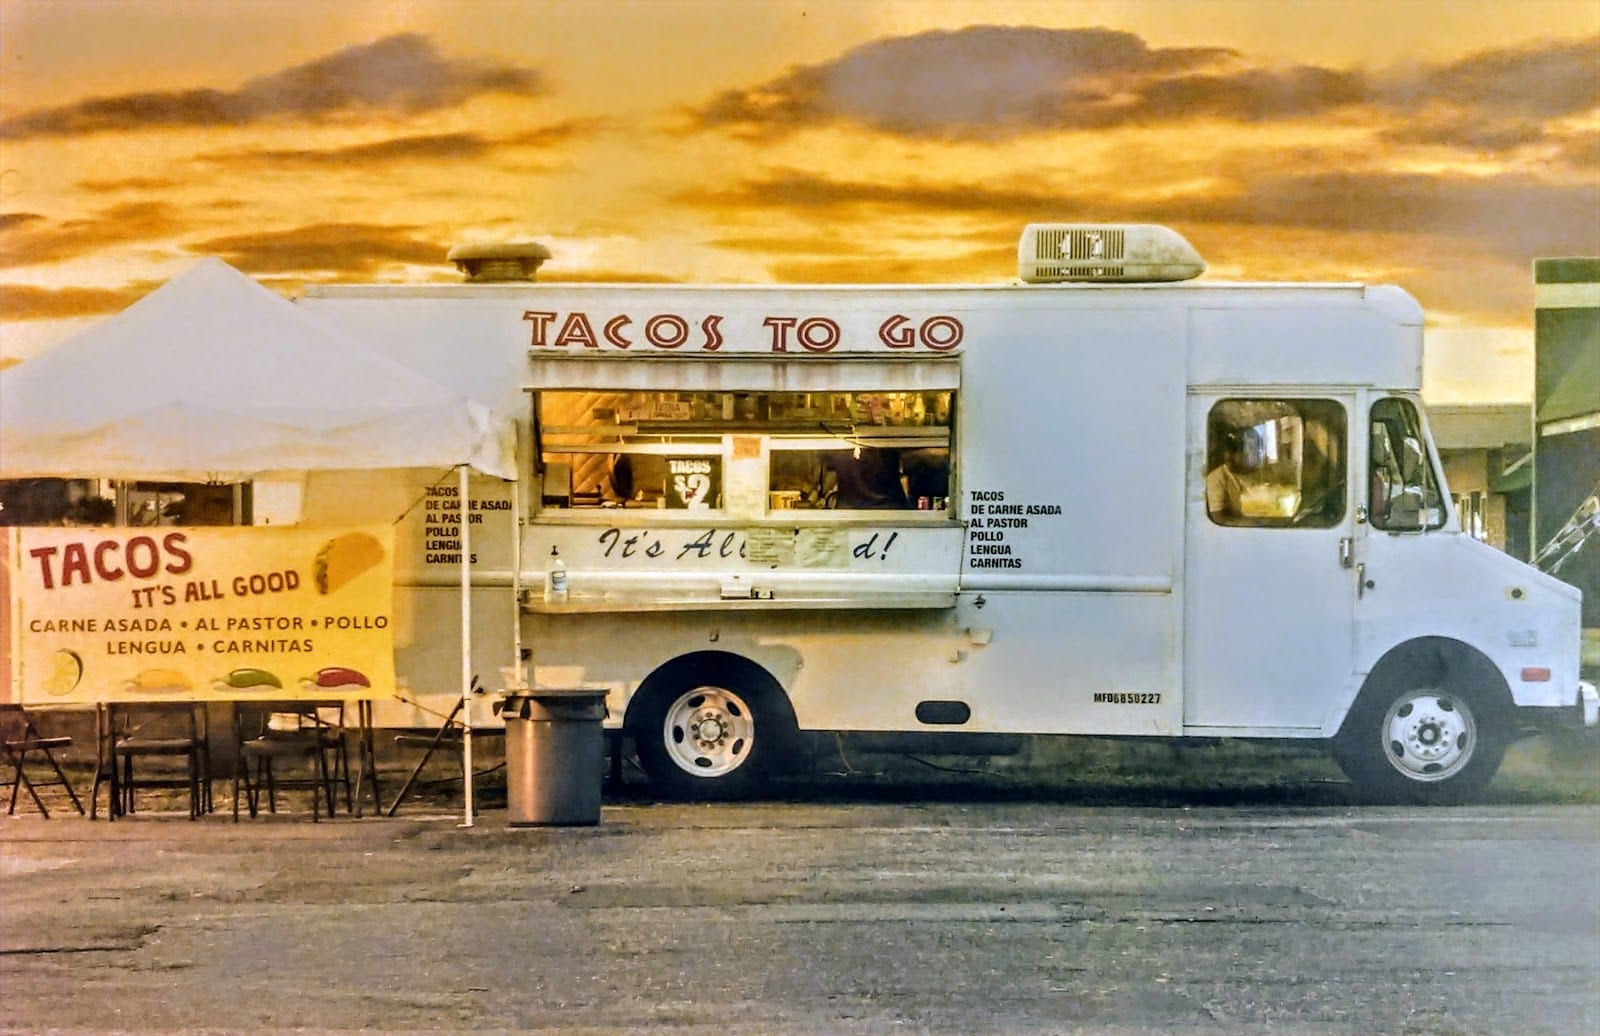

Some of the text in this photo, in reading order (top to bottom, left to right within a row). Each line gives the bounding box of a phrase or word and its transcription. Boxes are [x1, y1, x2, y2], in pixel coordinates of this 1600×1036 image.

[524, 311, 964, 353] TACOS TO GO
[669, 460, 711, 474] TACOS
[425, 487, 458, 497] TACOS
[971, 491, 1004, 501] TACOS
[426, 501, 439, 510] DE
[971, 505, 1062, 515] DE CARNE ASADA
[425, 514, 482, 523] AL PASOR
[971, 518, 1028, 528] AL PASTOR
[426, 527, 458, 536] POLLO
[970, 531, 1003, 541] POLLO
[426, 540, 463, 550] LENGU
[599, 528, 665, 558] It's
[970, 545, 1011, 555] LENGUA
[30, 532, 193, 590] TACOS
[426, 554, 477, 563] CARNITS
[970, 558, 1022, 568] CARNITAS
[131, 569, 300, 608] IT'S ALL GOOD
[30, 616, 388, 633] CARNE ASADA AL PASTOR POLLO
[107, 638, 314, 654] LENGUA CARNITAS
